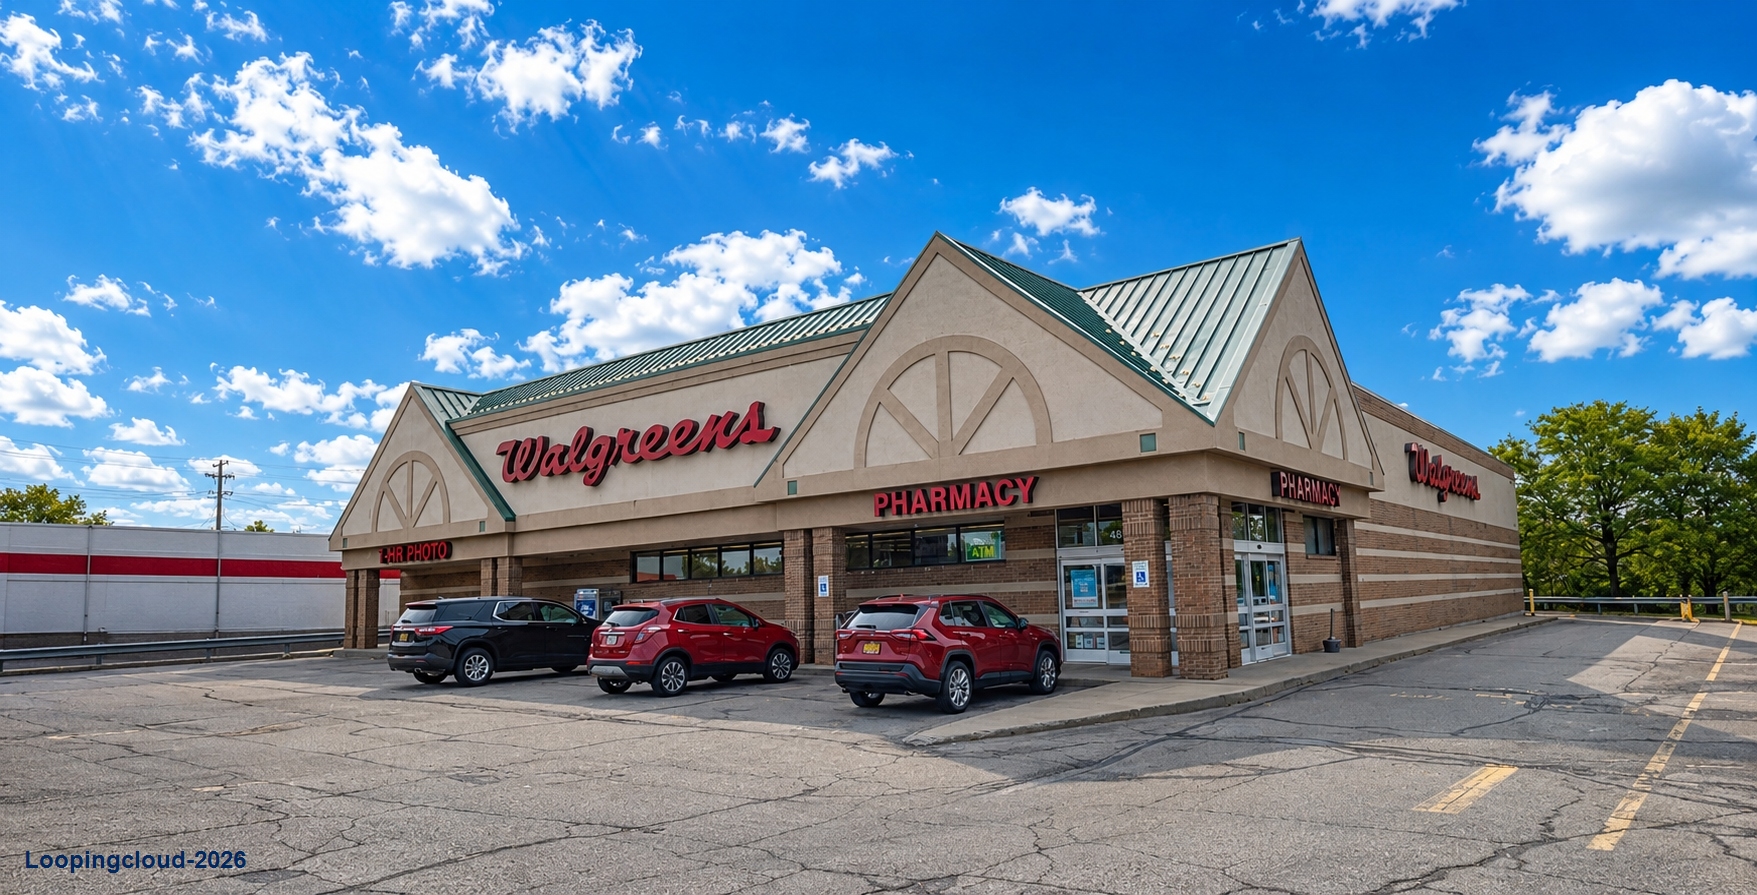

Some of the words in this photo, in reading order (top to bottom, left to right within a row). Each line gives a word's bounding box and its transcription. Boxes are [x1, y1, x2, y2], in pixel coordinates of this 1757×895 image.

[496, 400, 780, 487] Walgreens
[1279, 471, 1341, 507] PHARMACY
[1406, 442, 1481, 503] Walgreens
[874, 476, 1039, 517] PHARMACY
[407, 541, 449, 562] PHOTO
[972, 545, 995, 558] ATM
